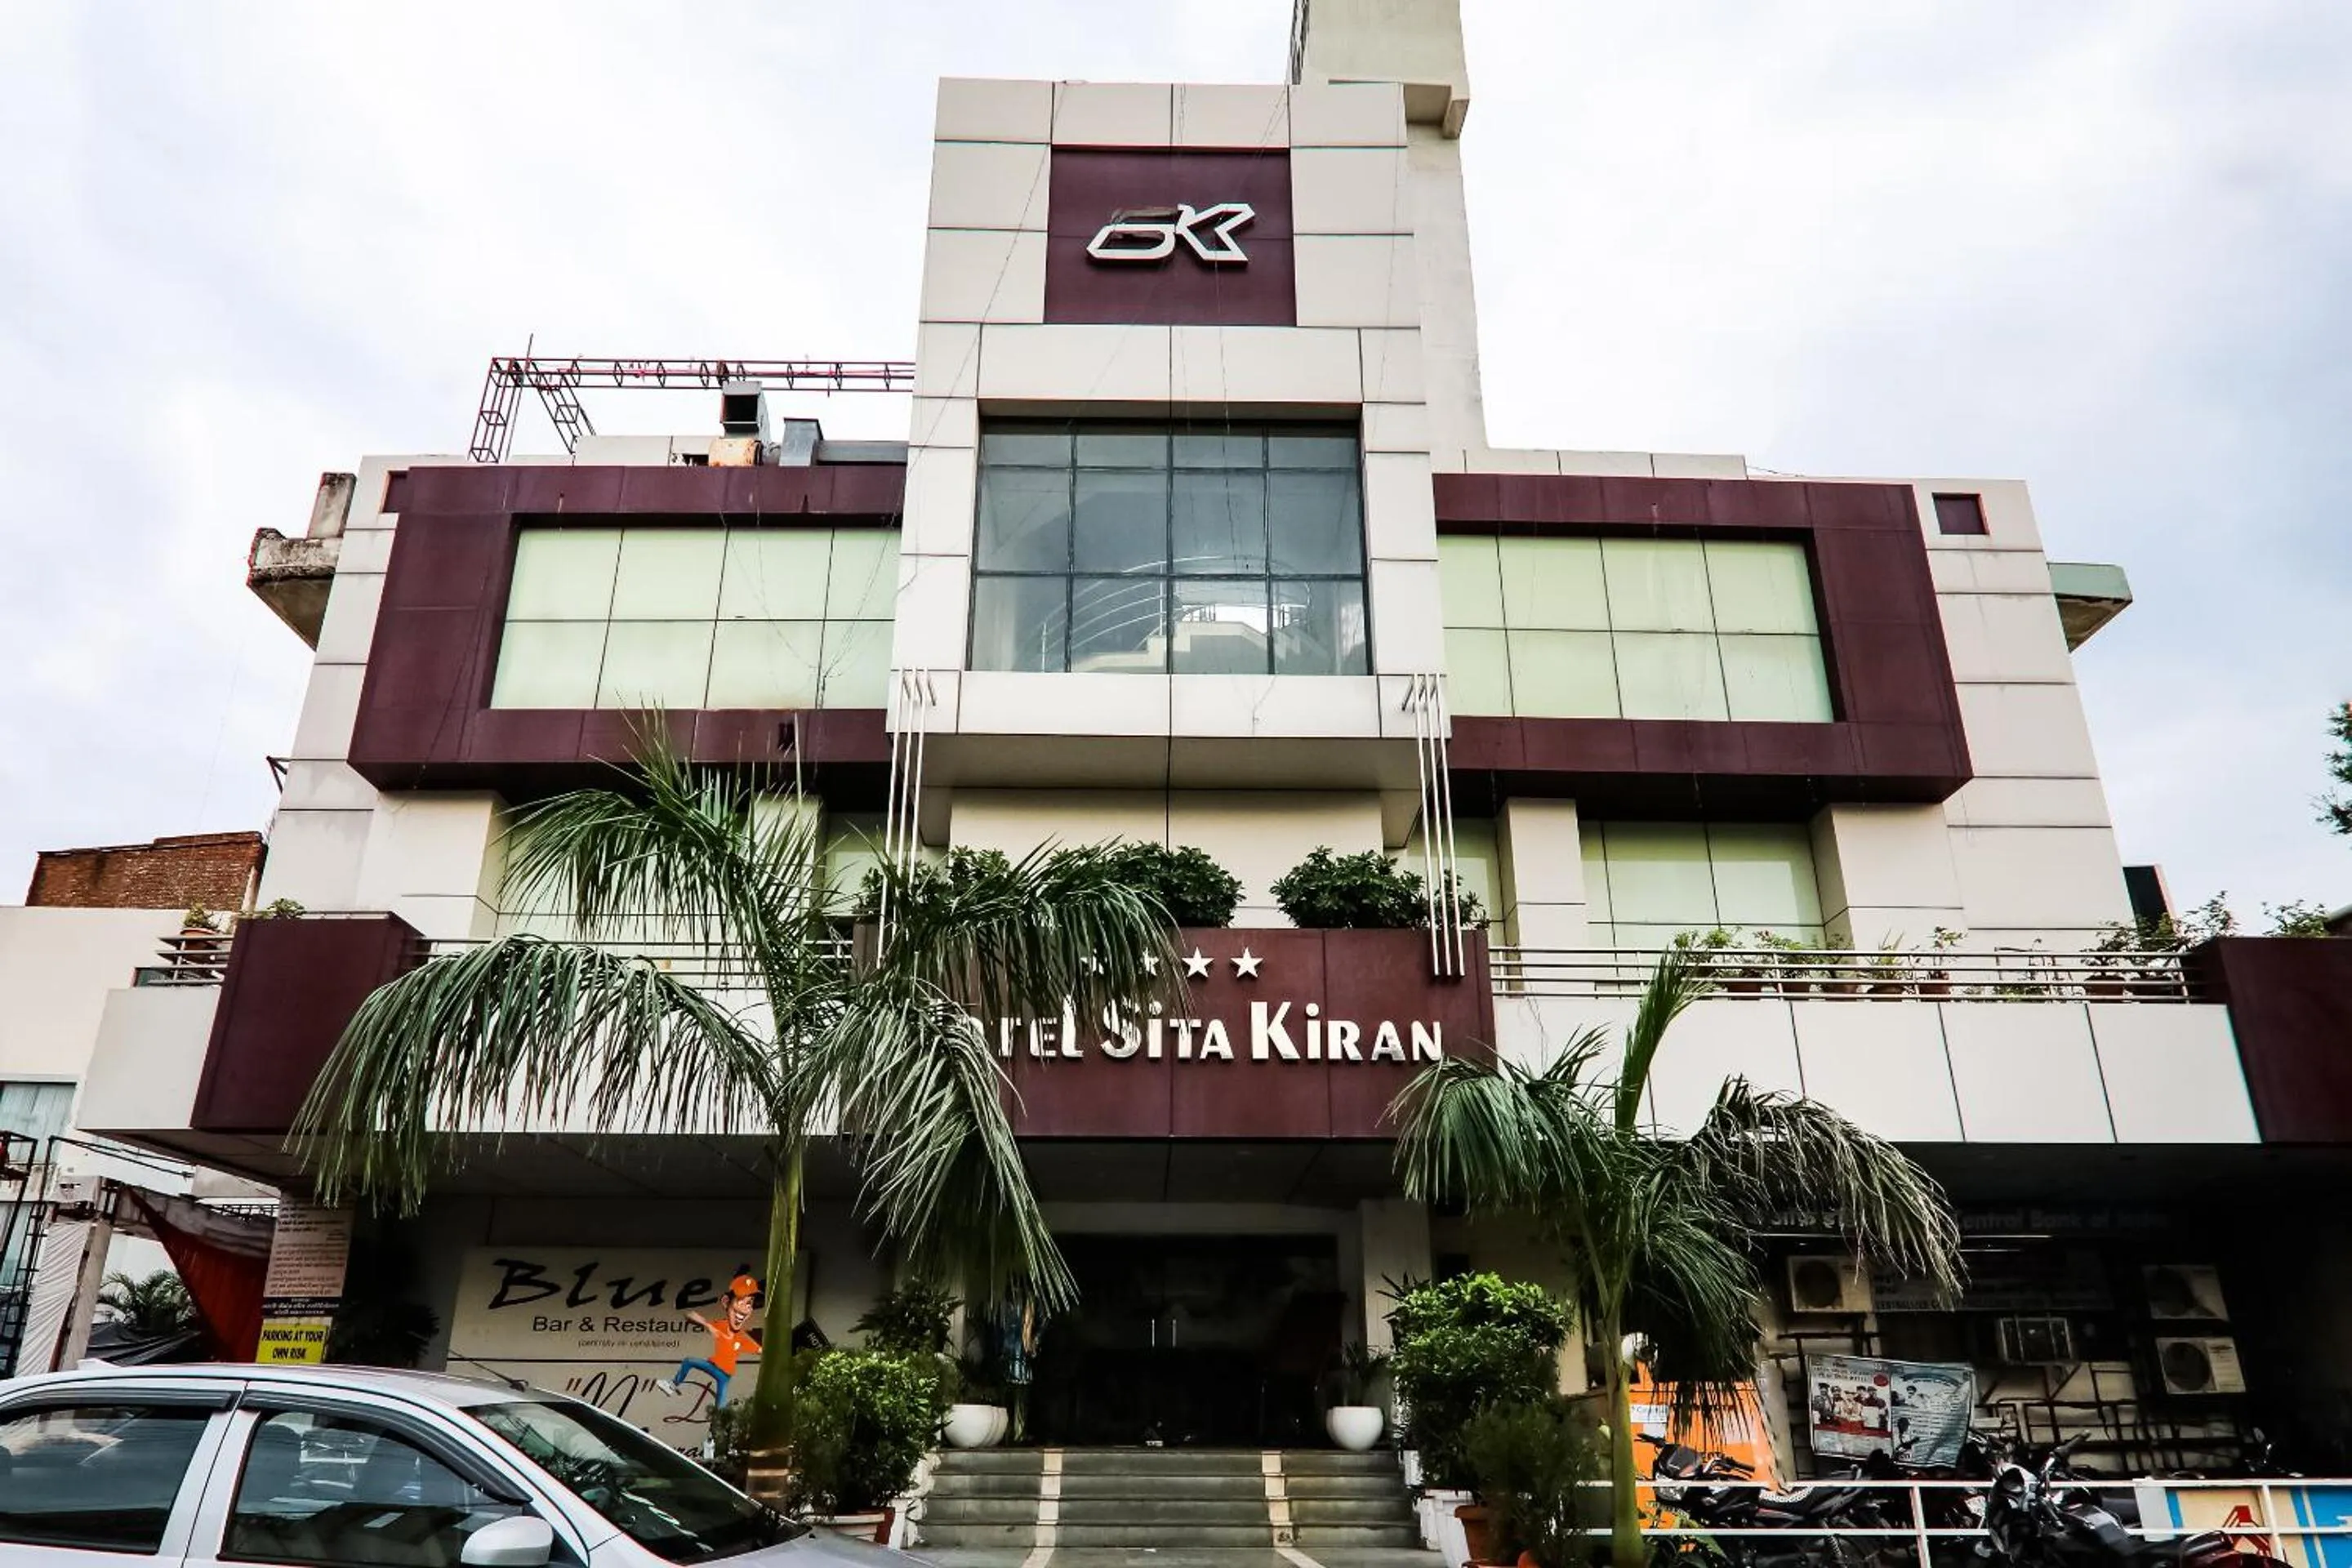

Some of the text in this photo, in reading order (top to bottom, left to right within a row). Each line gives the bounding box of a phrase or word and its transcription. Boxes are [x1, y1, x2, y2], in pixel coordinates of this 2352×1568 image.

[532, 1316, 712, 1333] Bar & Restaura
[262, 1330, 324, 1343] PARKING AT YOUR
[272, 1348, 306, 1359] OWN RISK
